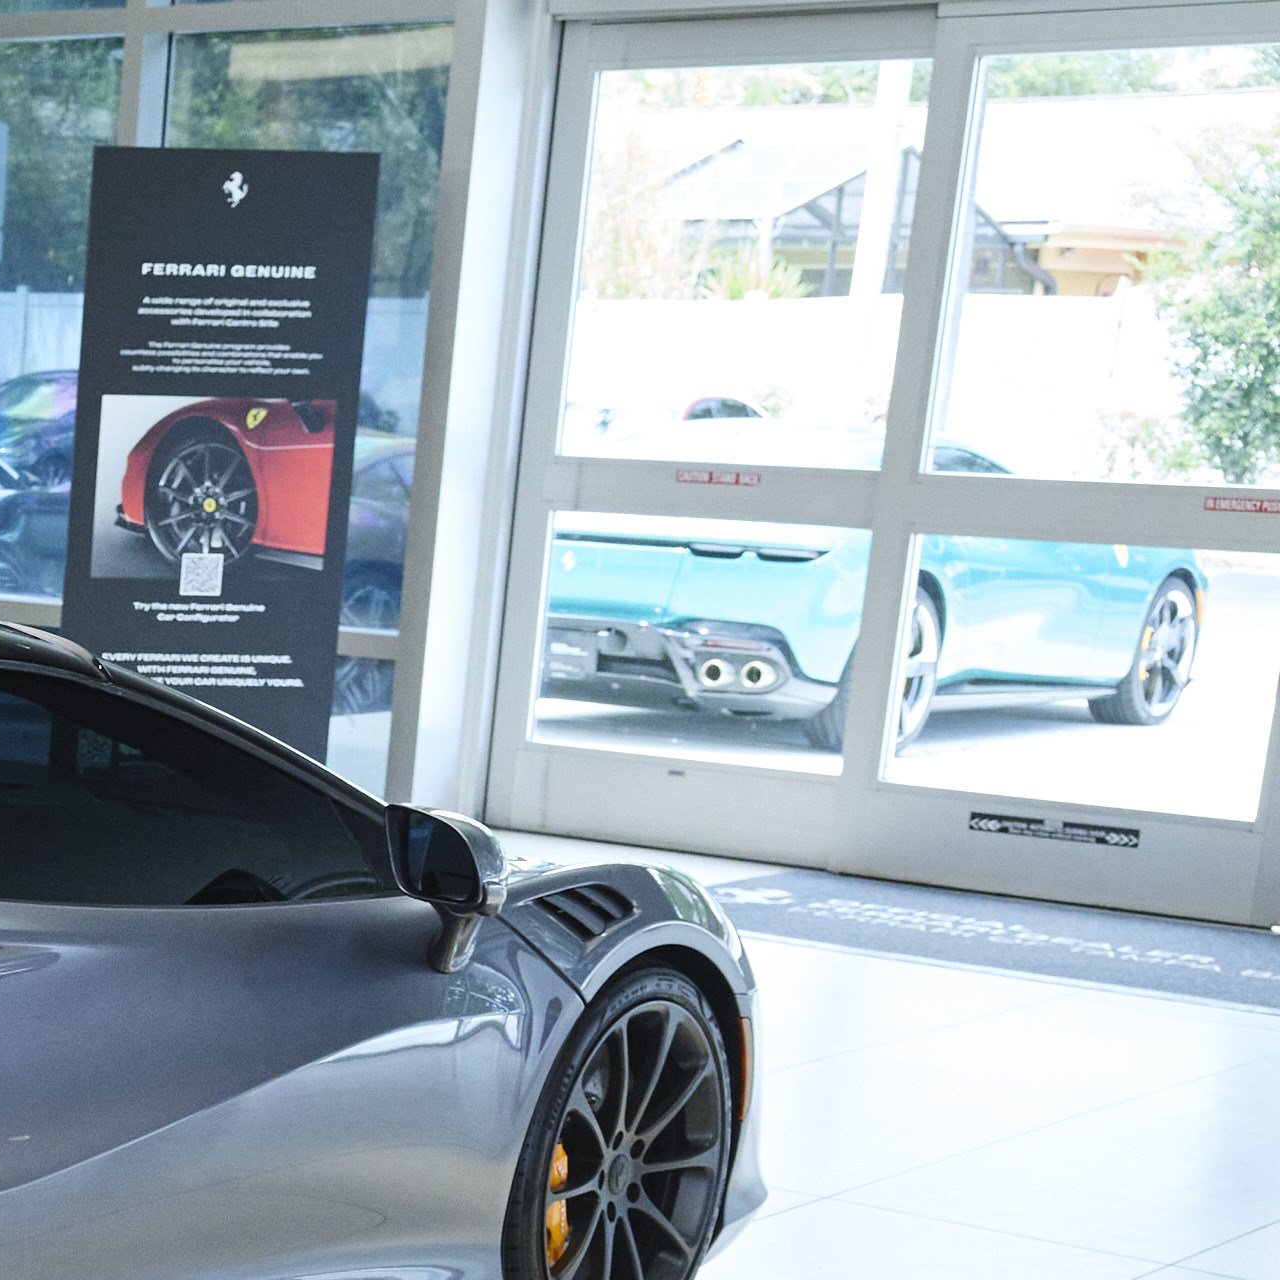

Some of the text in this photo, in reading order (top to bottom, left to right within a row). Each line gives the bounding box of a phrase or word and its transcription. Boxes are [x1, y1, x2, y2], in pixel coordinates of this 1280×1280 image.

[141, 262, 317, 279] FERRARI GENUINE
[132, 601, 151, 612] Try
[151, 602, 168, 610] the
[190, 602, 225, 611] Ferrari
[225, 603, 266, 612] Genuine
[156, 612, 240, 623] Car Configurator
[101, 652, 137, 661] EVERY
[137, 652, 181, 662] FERRARI
[181, 653, 199, 662] WE
[199, 654, 240, 663] CREATE
[240, 654, 251, 663] IS
[136, 665, 166, 674] WITH
[167, 665, 210, 674] FERRARI
[164, 677, 194, 686] YOUR
[194, 677, 216, 686] CAR
[216, 678, 266, 687] UNIQUELY
